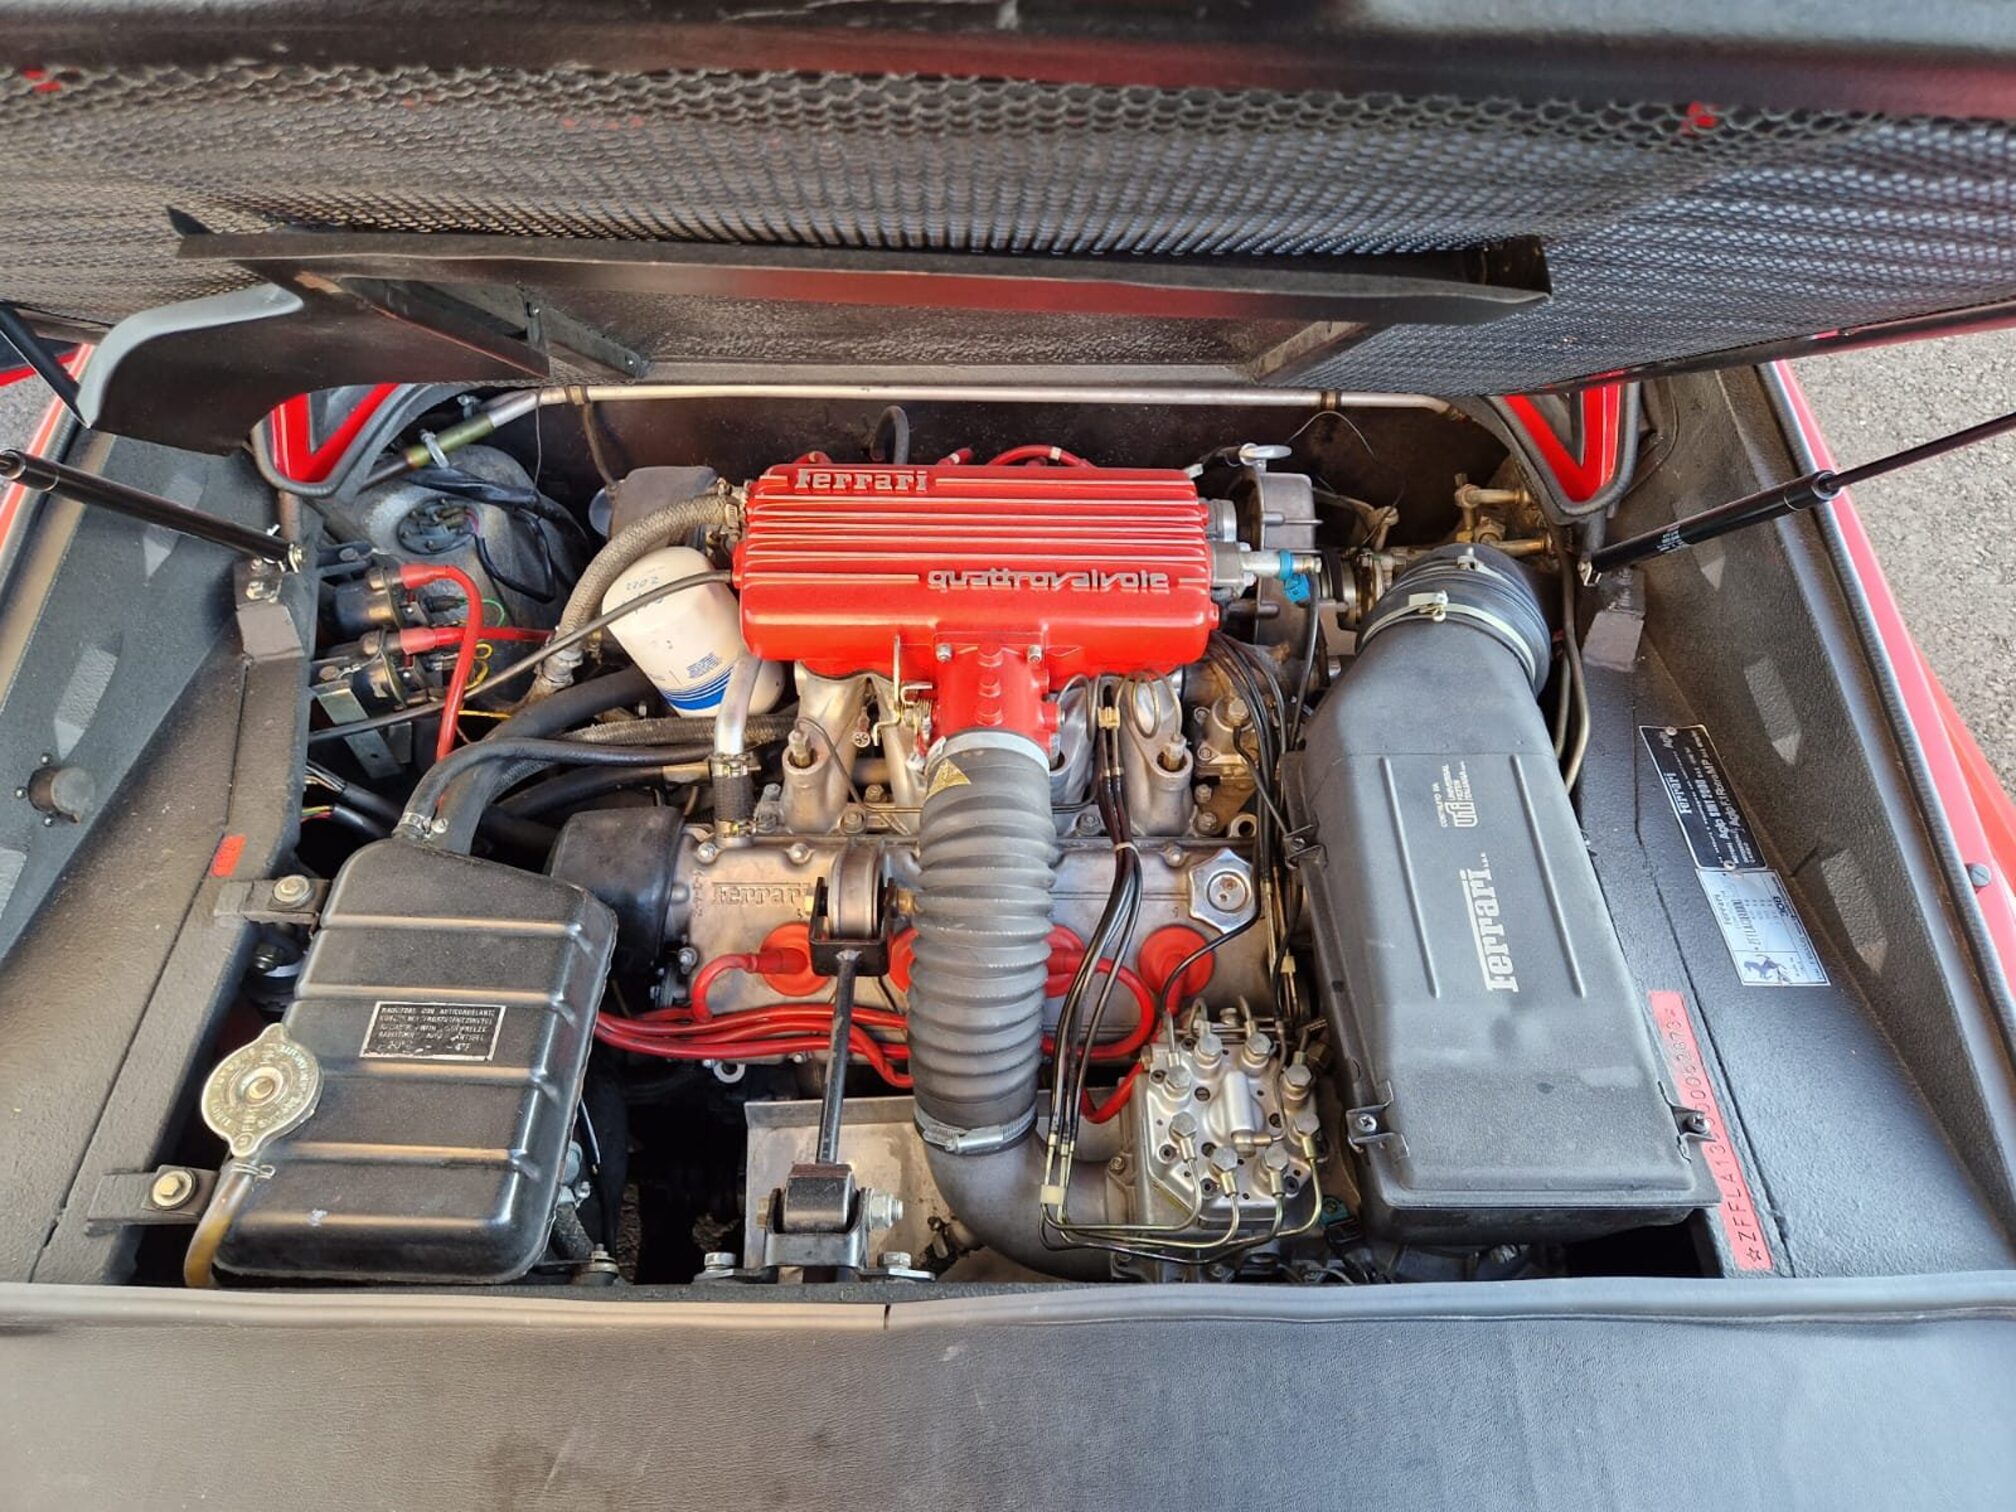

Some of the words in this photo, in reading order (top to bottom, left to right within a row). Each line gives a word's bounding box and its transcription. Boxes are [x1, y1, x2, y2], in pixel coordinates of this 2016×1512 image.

[794, 468, 928, 493] Ferrari
[927, 567, 1170, 594] quattrovalvole
[1664, 772, 1692, 814] Ferrari
[1459, 869, 1519, 993] Ferrari
